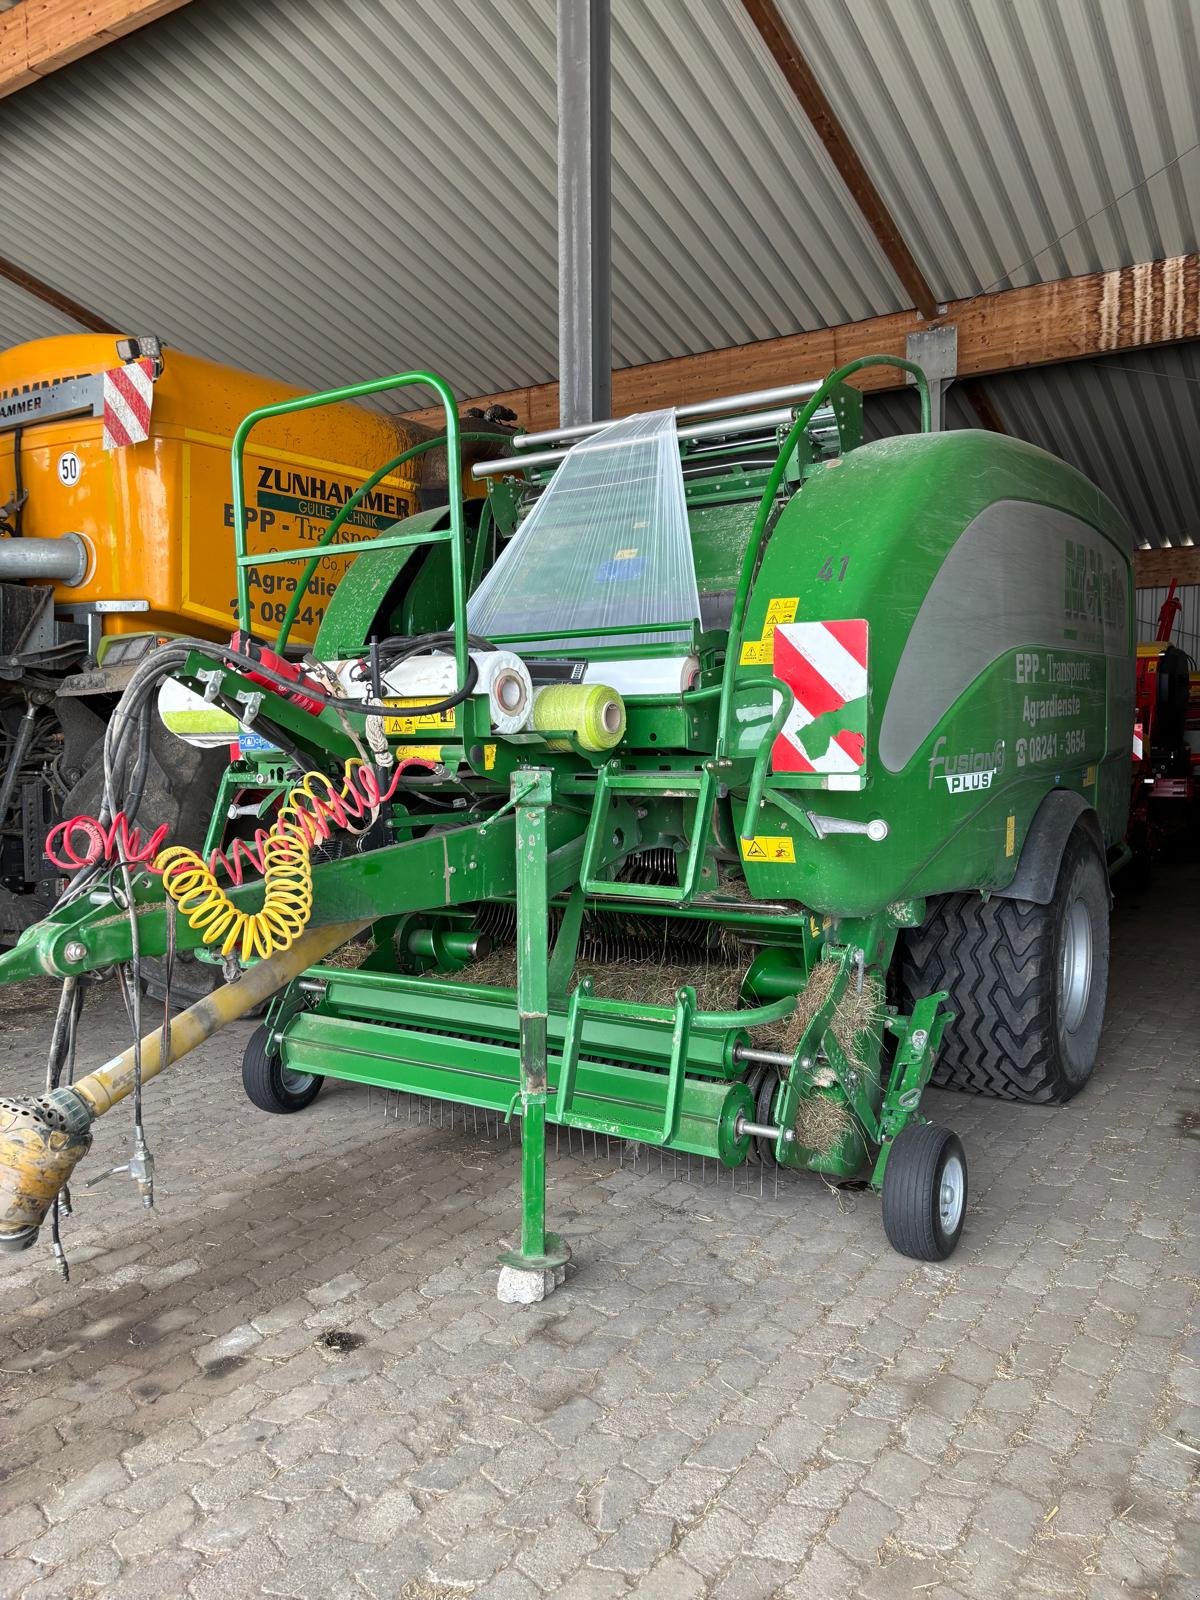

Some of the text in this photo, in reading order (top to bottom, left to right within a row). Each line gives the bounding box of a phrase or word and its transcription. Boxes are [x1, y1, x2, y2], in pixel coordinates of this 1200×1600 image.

[62, 458, 76, 480] 50
[816, 555, 849, 582] 41
[1015, 653, 1039, 684] EPP
[1023, 695, 1080, 728] Agrardienste
[1029, 733, 1057, 763] 08241
[1065, 729, 1086, 755] 3654
[951, 773, 989, 792] PLUS
